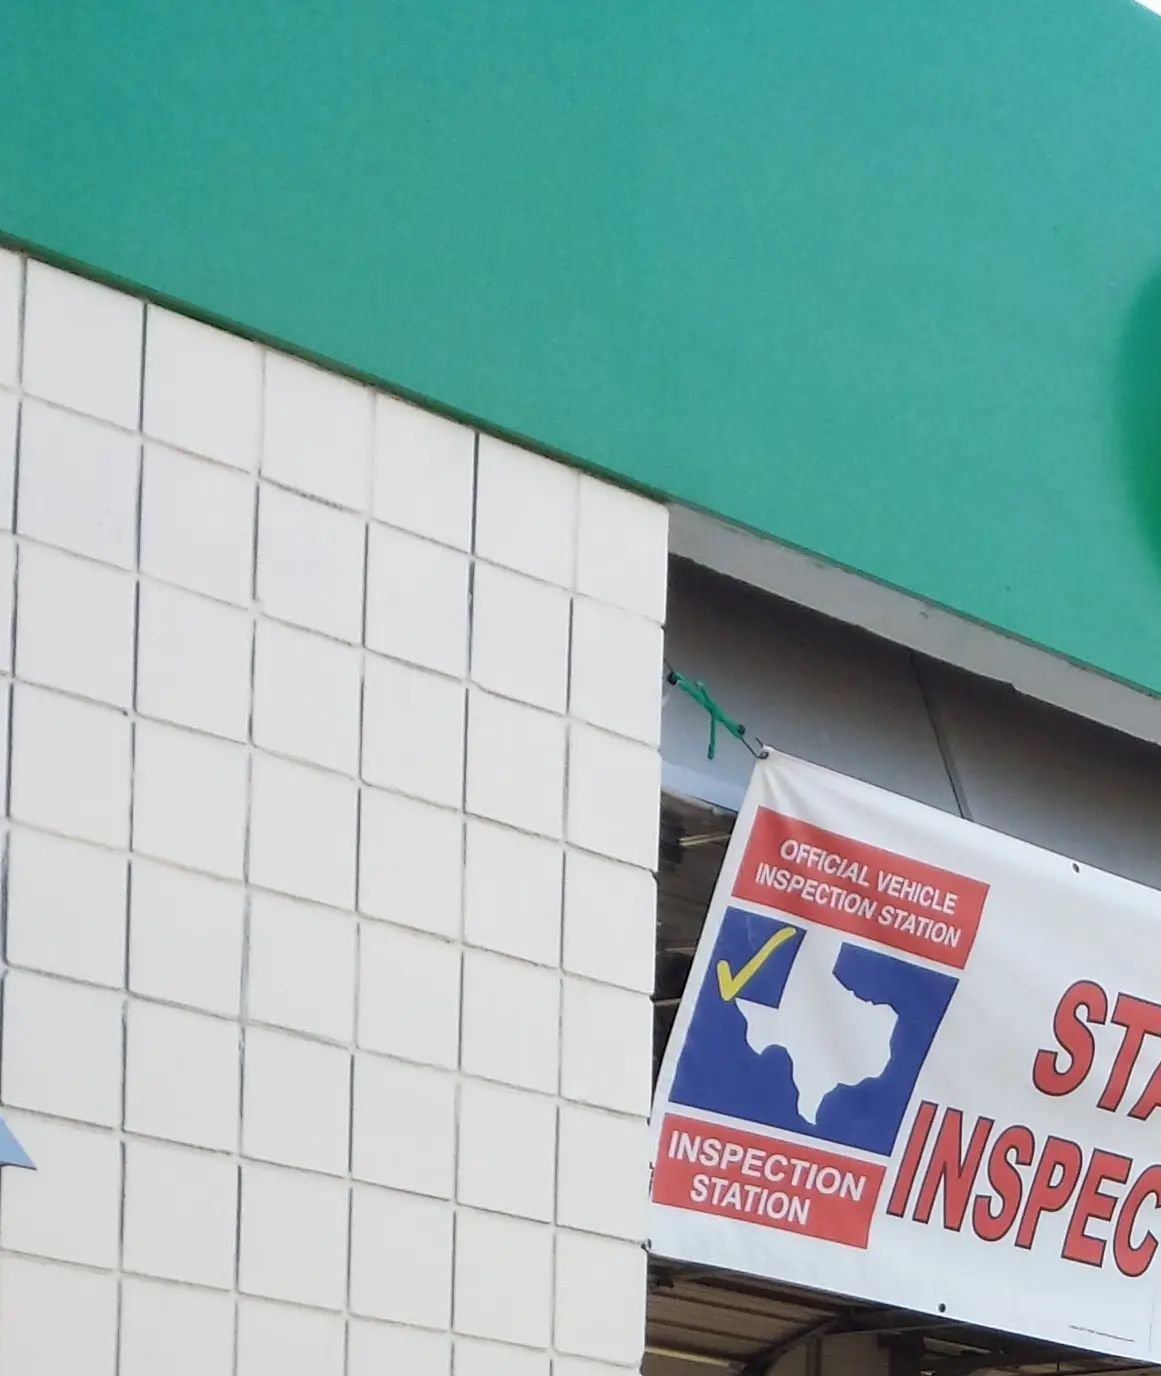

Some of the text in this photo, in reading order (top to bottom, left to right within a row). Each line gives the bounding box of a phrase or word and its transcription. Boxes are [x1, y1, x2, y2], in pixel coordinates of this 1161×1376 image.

[755, 863, 961, 948] INSPECTION STATION
[779, 840, 958, 915] OFFICIAL VEHICLE
[667, 1130, 867, 1202] INSPECTION
[690, 1174, 811, 1225] STATION
